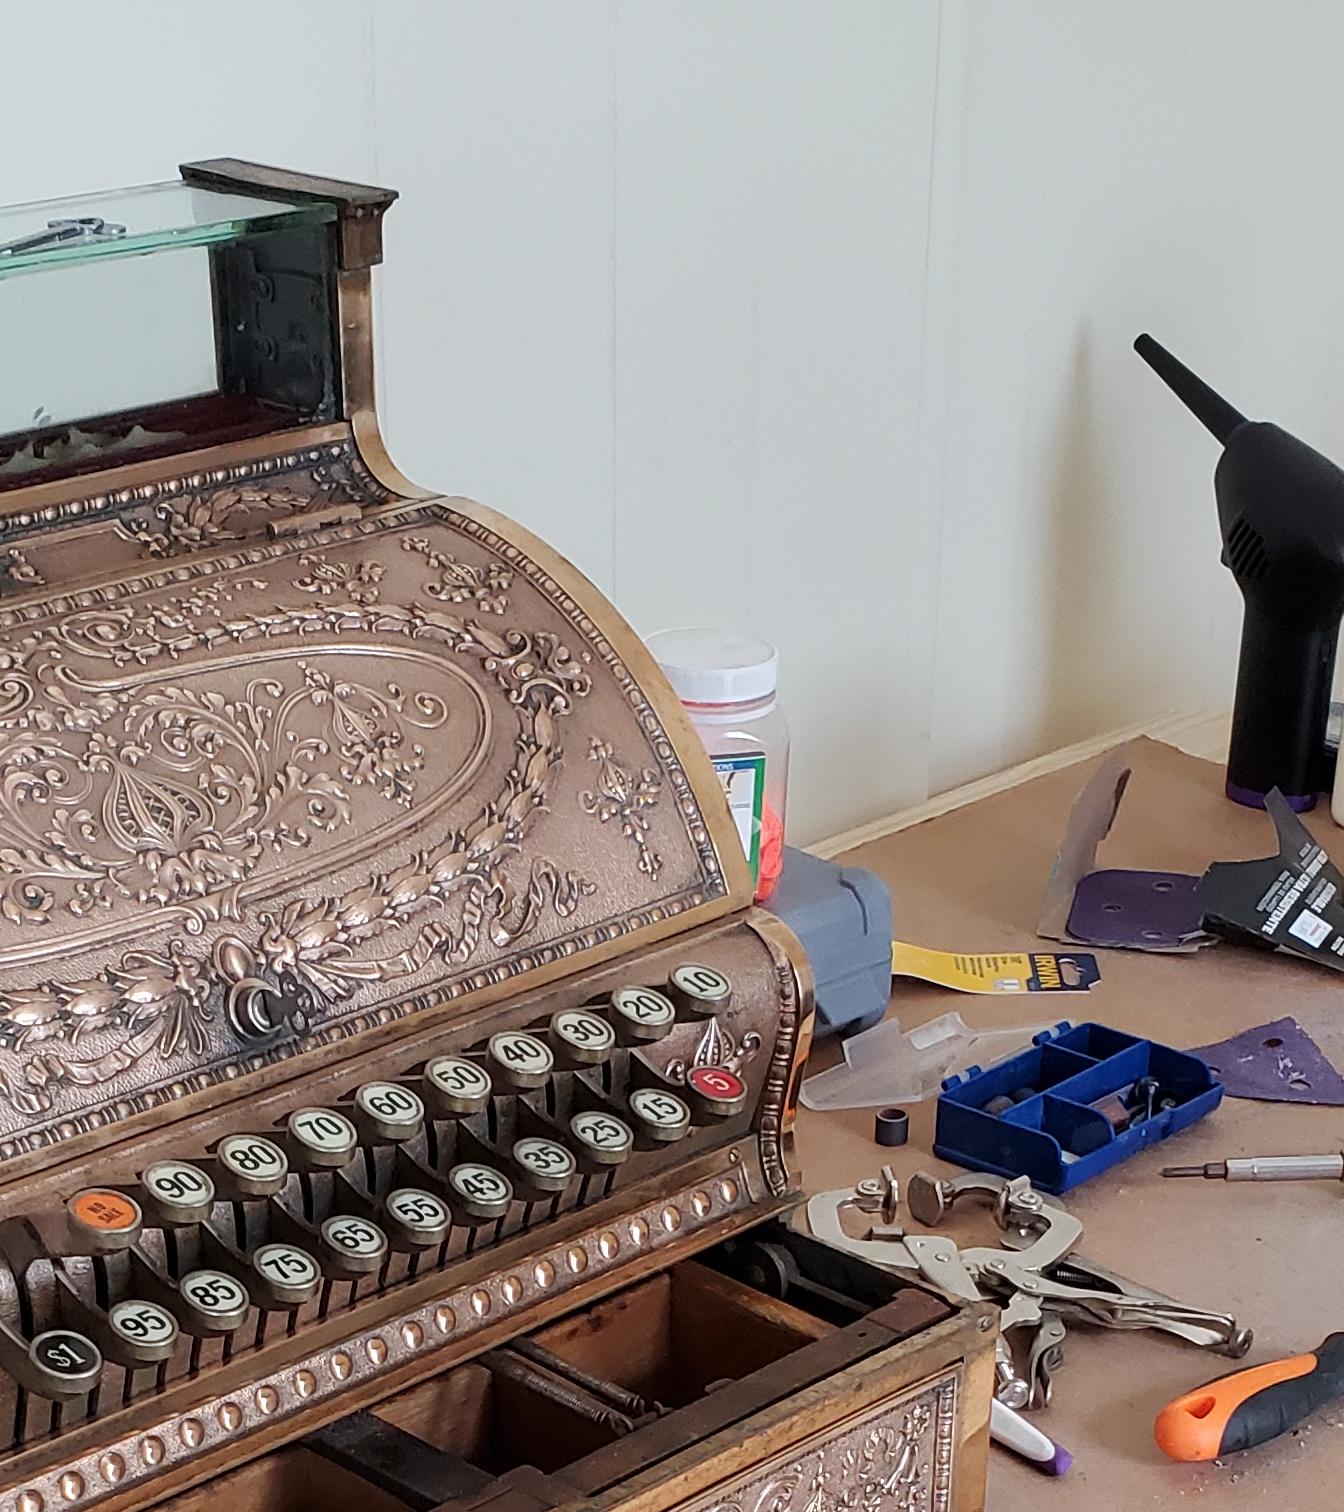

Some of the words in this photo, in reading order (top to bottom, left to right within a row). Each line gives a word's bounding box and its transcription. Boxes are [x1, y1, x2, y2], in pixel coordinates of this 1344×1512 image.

[683, 971, 721, 993] 10
[1034, 954, 1062, 990] IRWIN
[622, 995, 664, 1019] 20
[562, 1020, 604, 1041] 30
[502, 1040, 540, 1063] 40
[436, 1066, 481, 1090] 50
[703, 1074, 730, 1091] 5
[369, 1091, 413, 1115] 60
[642, 1097, 678, 1121] 15
[297, 1117, 343, 1141] 70
[580, 1120, 621, 1144] 25
[230, 1144, 277, 1170] 80
[524, 1146, 565, 1169] 35
[155, 1171, 203, 1198] 90
[462, 1173, 500, 1196] 45
[87, 1202, 107, 1214] NO
[98, 1207, 125, 1224] SALE
[396, 1198, 440, 1223] 55
[331, 1223, 375, 1248] 65
[263, 1254, 308, 1279] 75
[190, 1280, 236, 1306] 85
[120, 1310, 167, 1337] 95
[47, 1343, 86, 1367] $1
